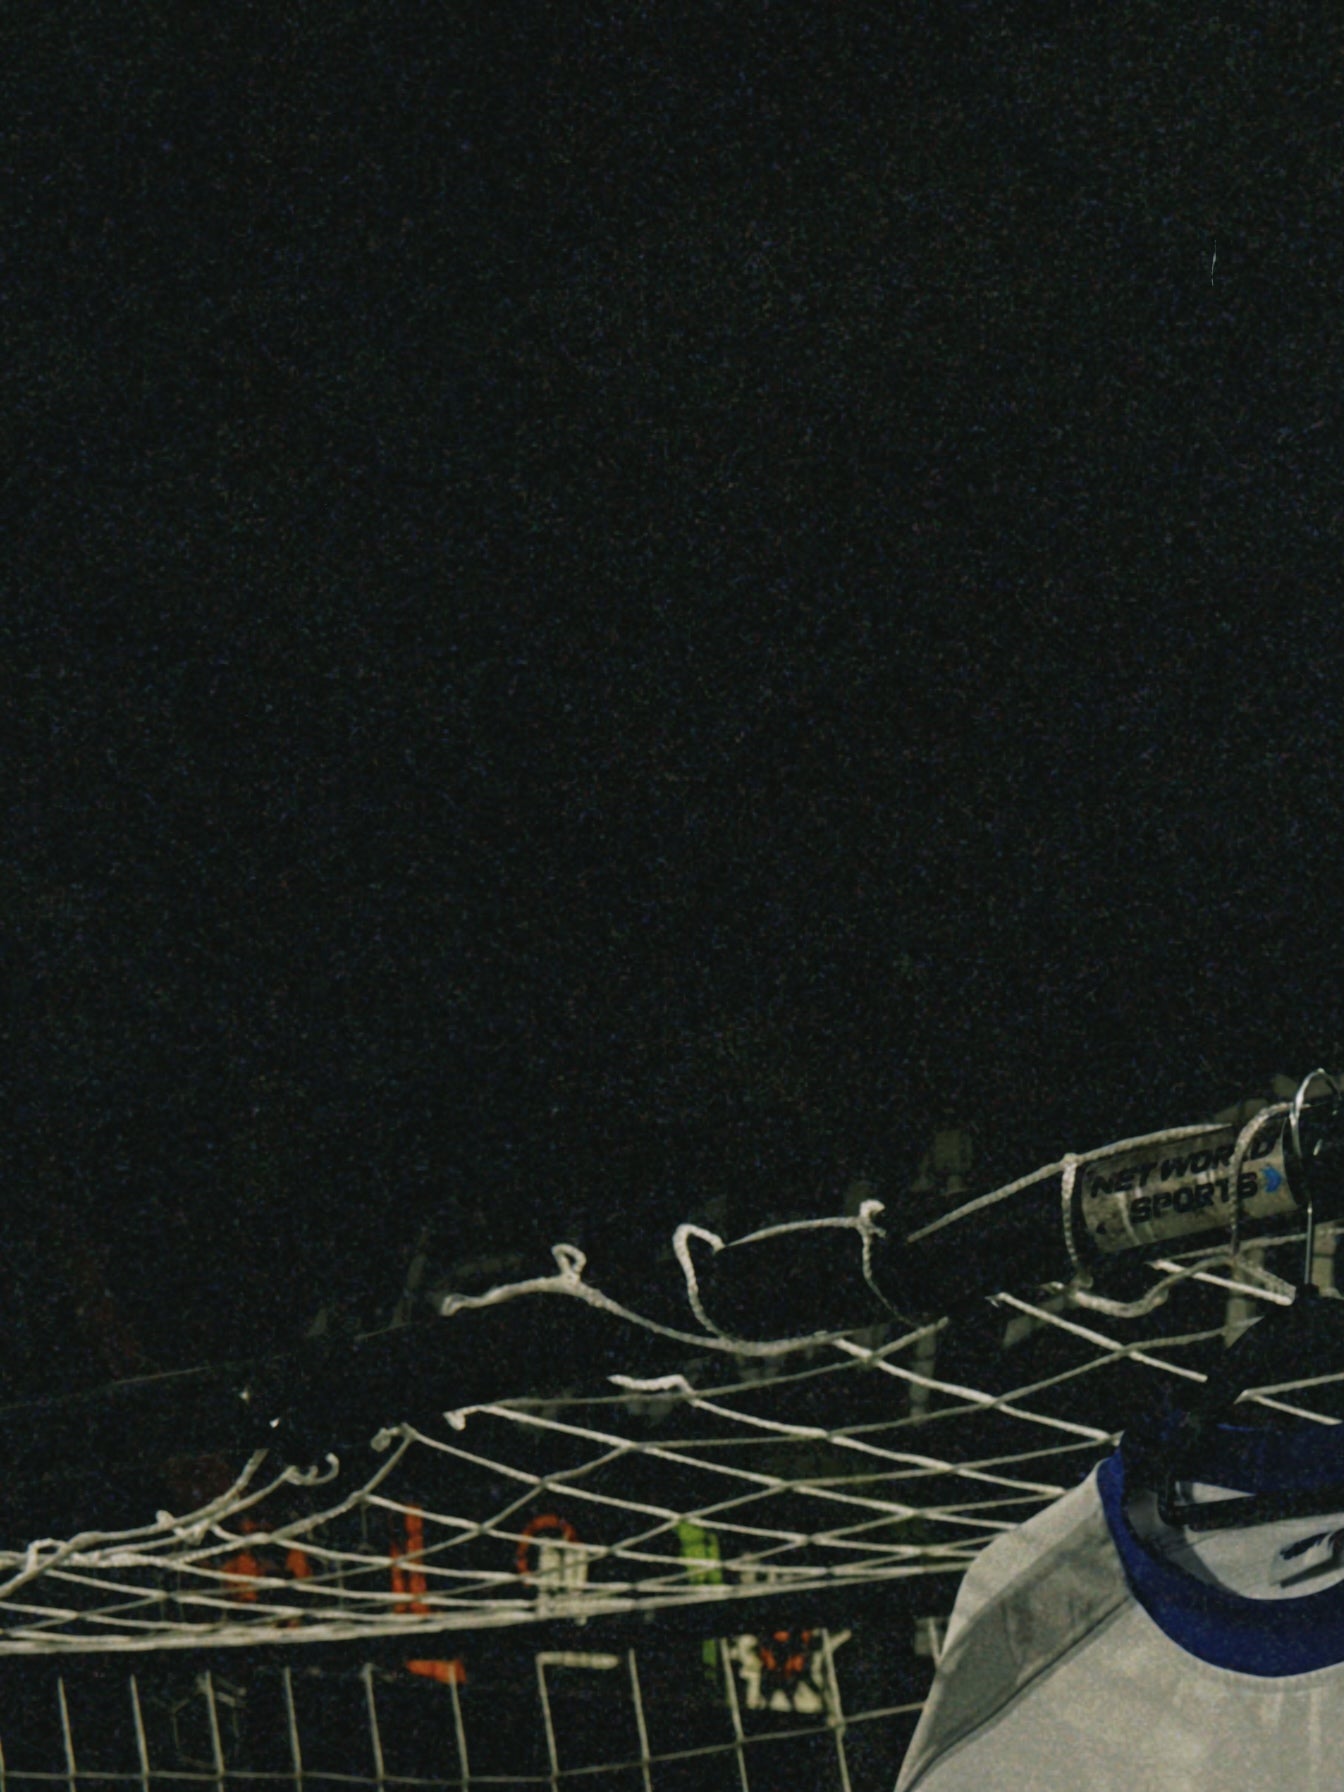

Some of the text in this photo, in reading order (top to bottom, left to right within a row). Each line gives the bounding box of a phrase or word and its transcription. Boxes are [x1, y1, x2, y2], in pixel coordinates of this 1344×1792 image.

[1090, 1138, 1277, 1199] NET WORD
[1131, 1171, 1259, 1224] SPORTS
